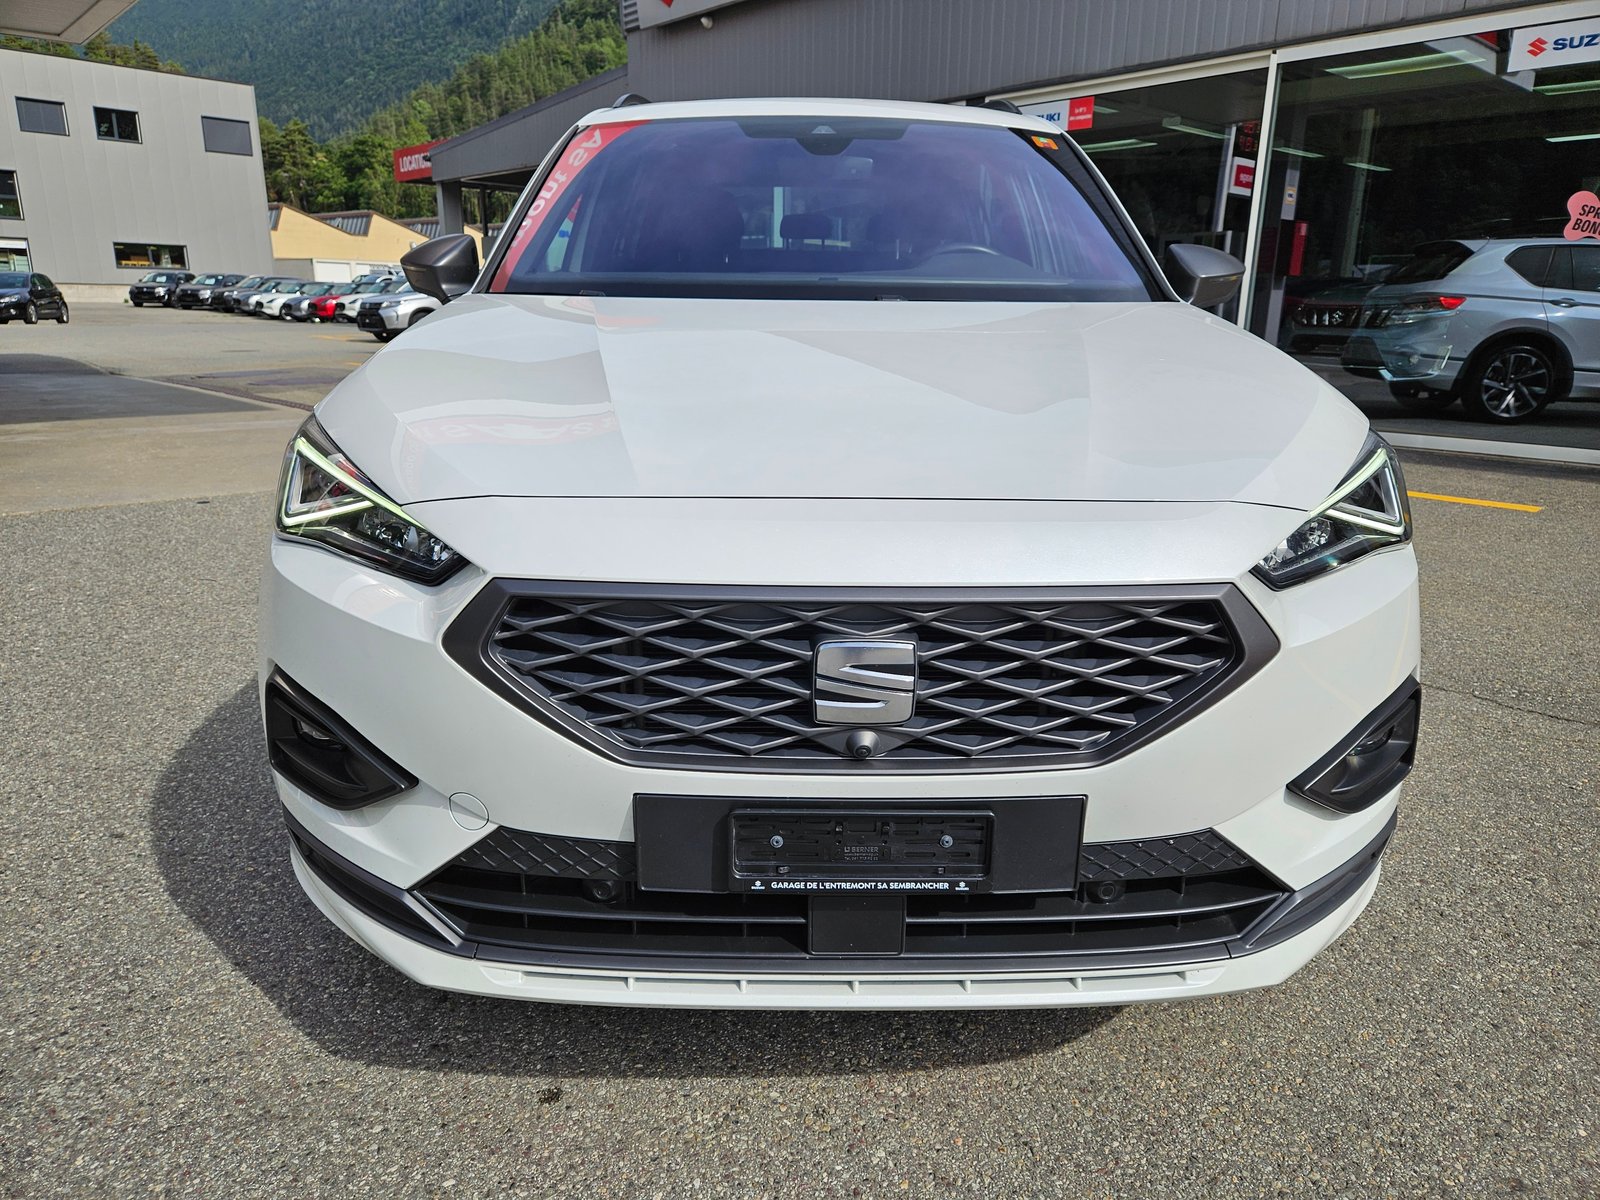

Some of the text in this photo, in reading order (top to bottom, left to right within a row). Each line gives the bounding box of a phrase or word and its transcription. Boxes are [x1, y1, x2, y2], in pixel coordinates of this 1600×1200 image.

[1552, 33, 1600, 51] SUZ
[770, 881, 805, 889] GARAGE
[819, 882, 876, 890] L'ENTREMONT
[877, 882, 888, 890] SA
[889, 882, 950, 890] SEMBRANCHER
